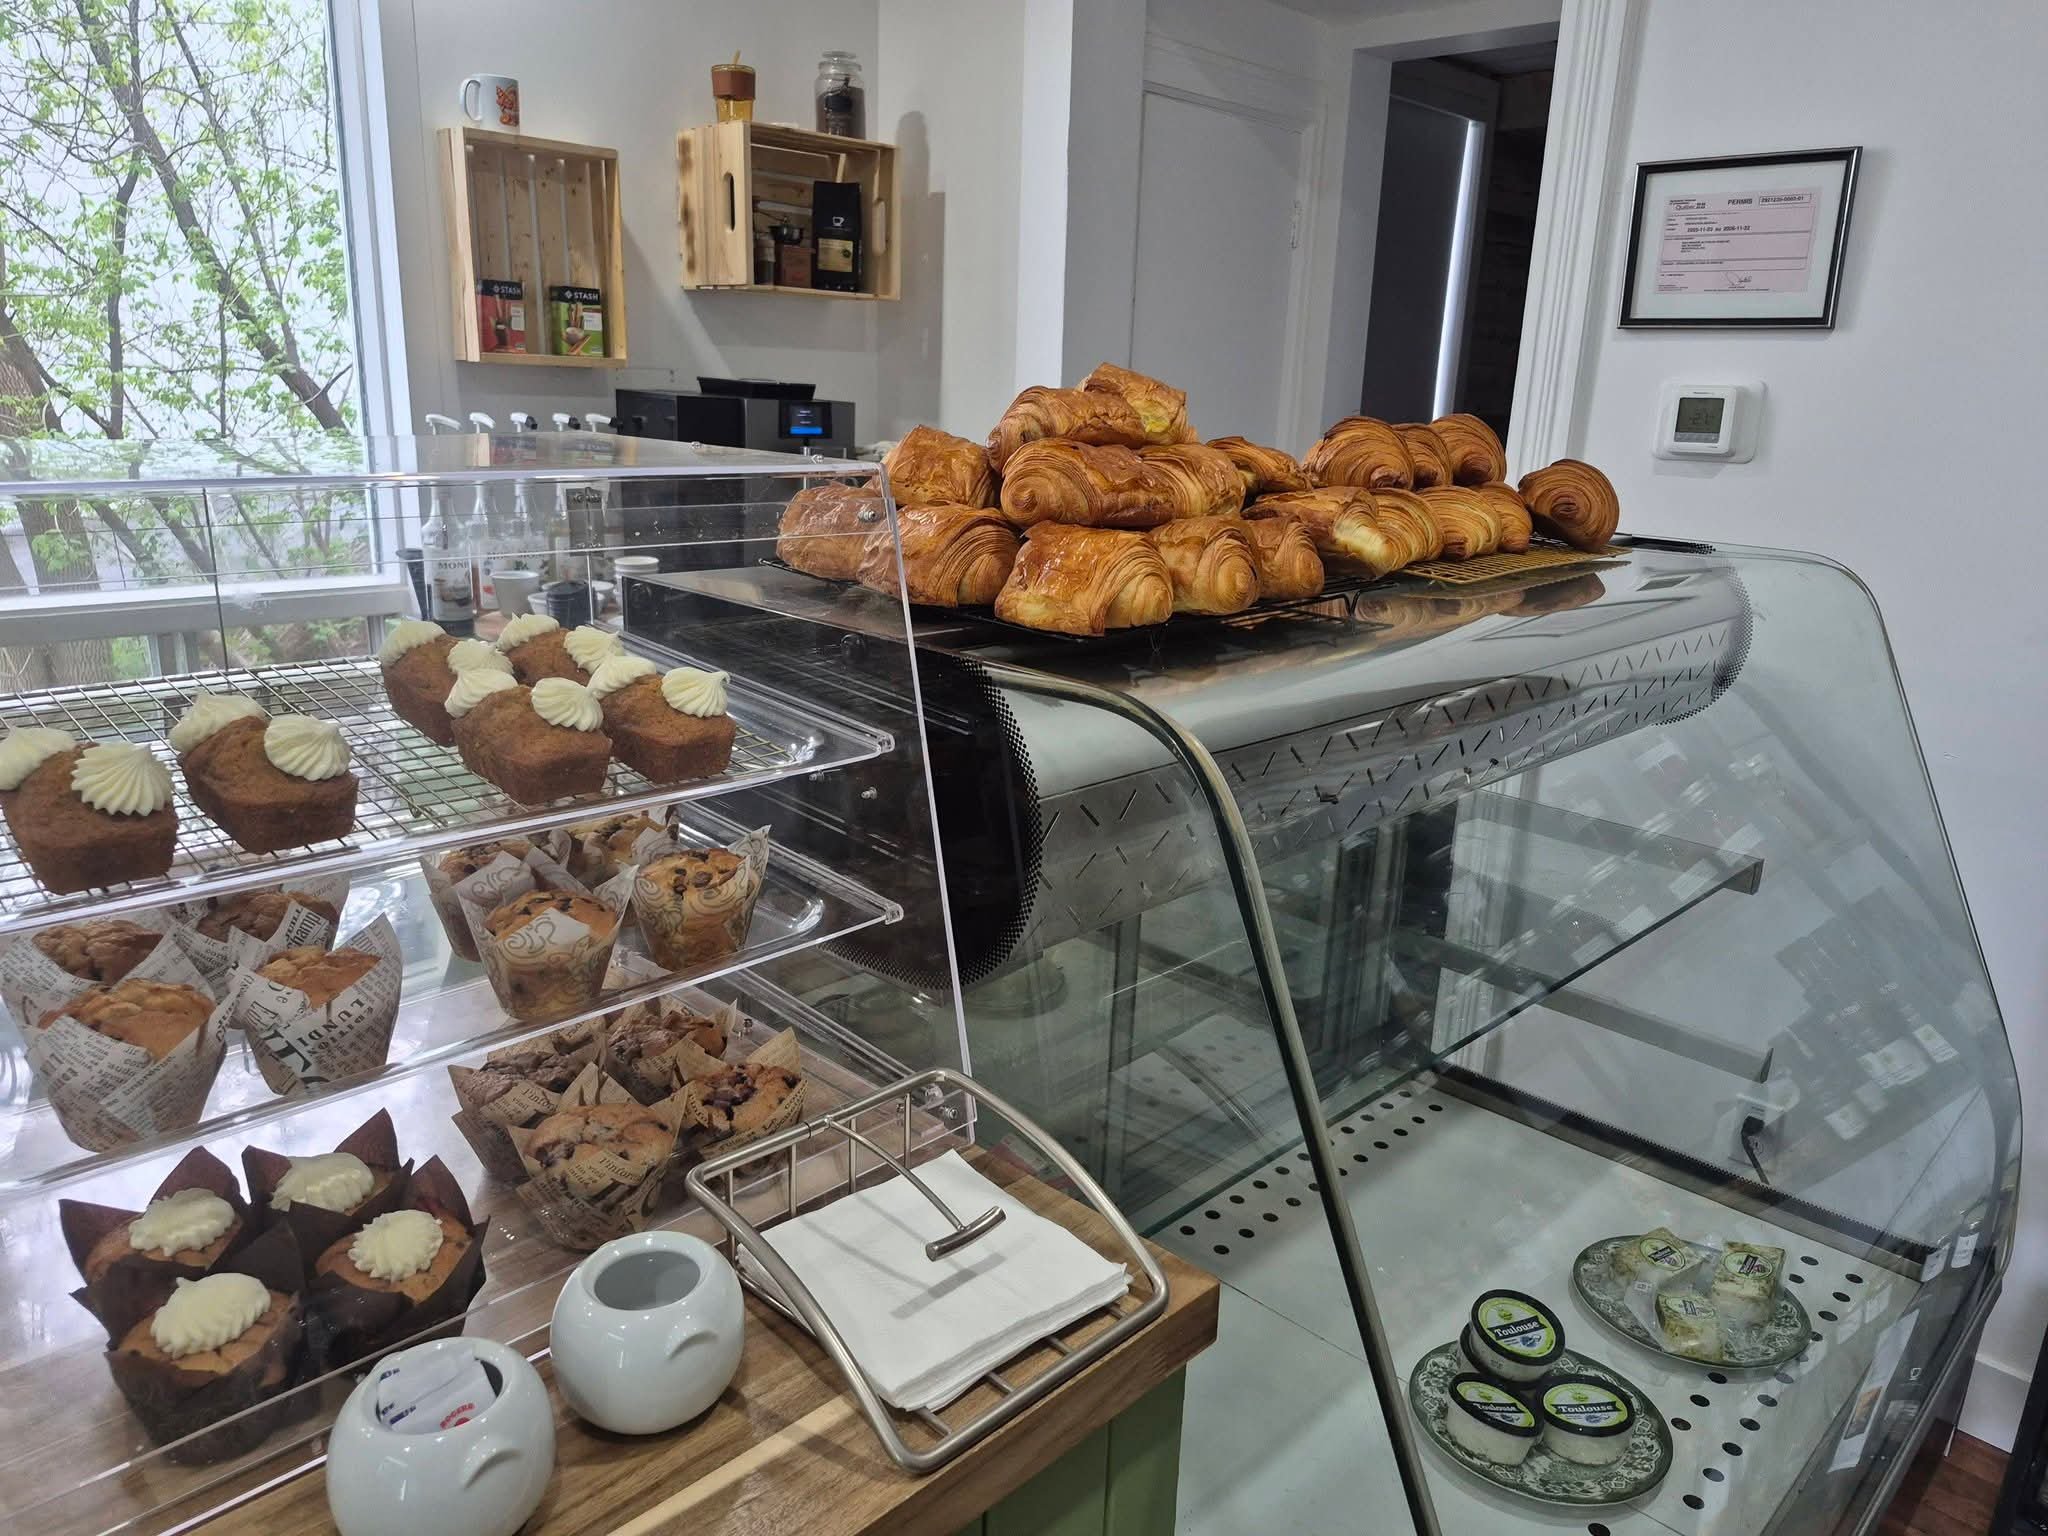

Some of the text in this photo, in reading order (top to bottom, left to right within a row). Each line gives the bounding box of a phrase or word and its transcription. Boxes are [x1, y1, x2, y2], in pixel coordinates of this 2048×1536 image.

[500, 286, 521, 295] STASH
[573, 291, 599, 301] STASH
[296, 998, 365, 1047] LUNDI
[1493, 1319, 1540, 1338] Toulouse
[1557, 1403, 1615, 1413] Toulouse
